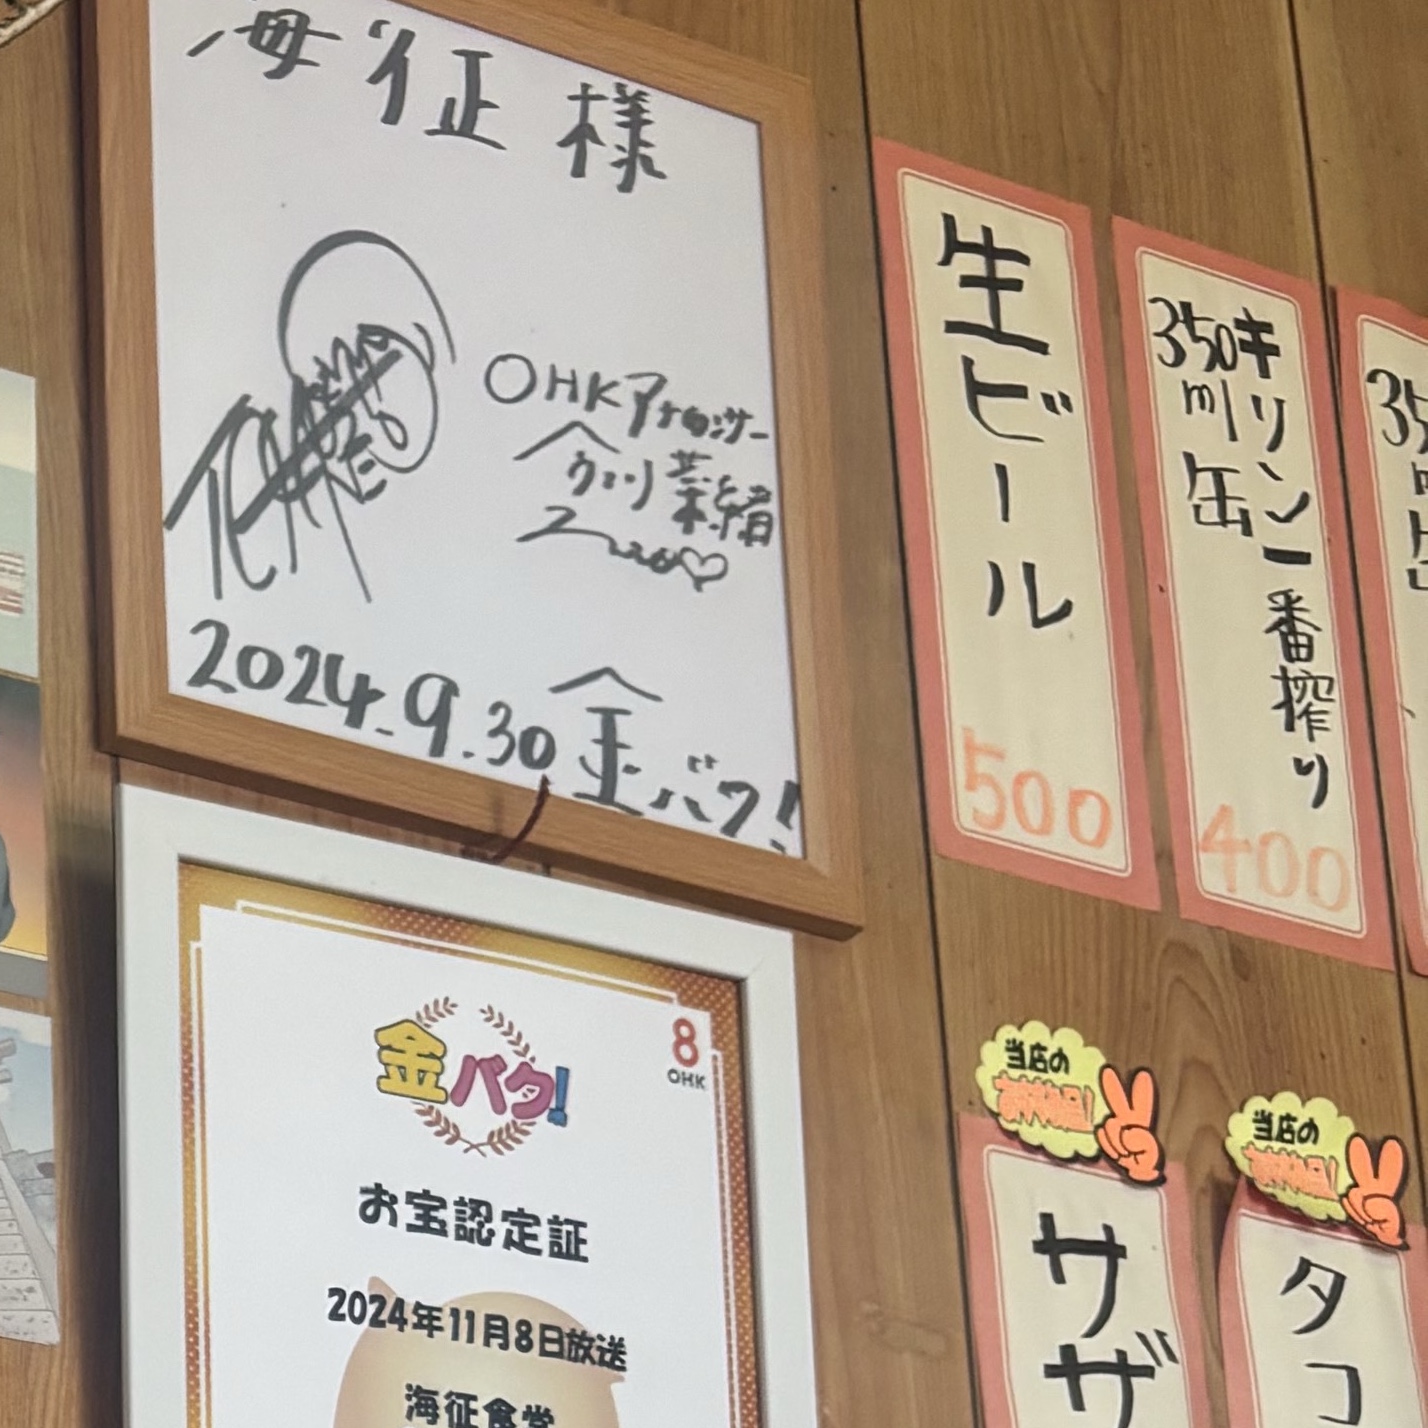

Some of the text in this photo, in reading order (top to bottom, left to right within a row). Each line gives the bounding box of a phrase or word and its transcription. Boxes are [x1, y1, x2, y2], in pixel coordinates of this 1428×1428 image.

[937, 212, 1074, 630] 生ビール
[1233, 307, 1337, 809] キリン一番搾り
[187, 618, 557, 771] 2024.9.30
[961, 726, 1112, 849] 500
[1199, 804, 1351, 914] 400
[667, 1068, 707, 1091] OHK
[672, 1016, 700, 1068] 8
[1005, 1037, 1070, 1075] 当店の
[1252, 1108, 1320, 1146] 当店の
[358, 1182, 590, 1264] お宝認定証
[327, 1286, 628, 1373] 2024年11月8日放送
